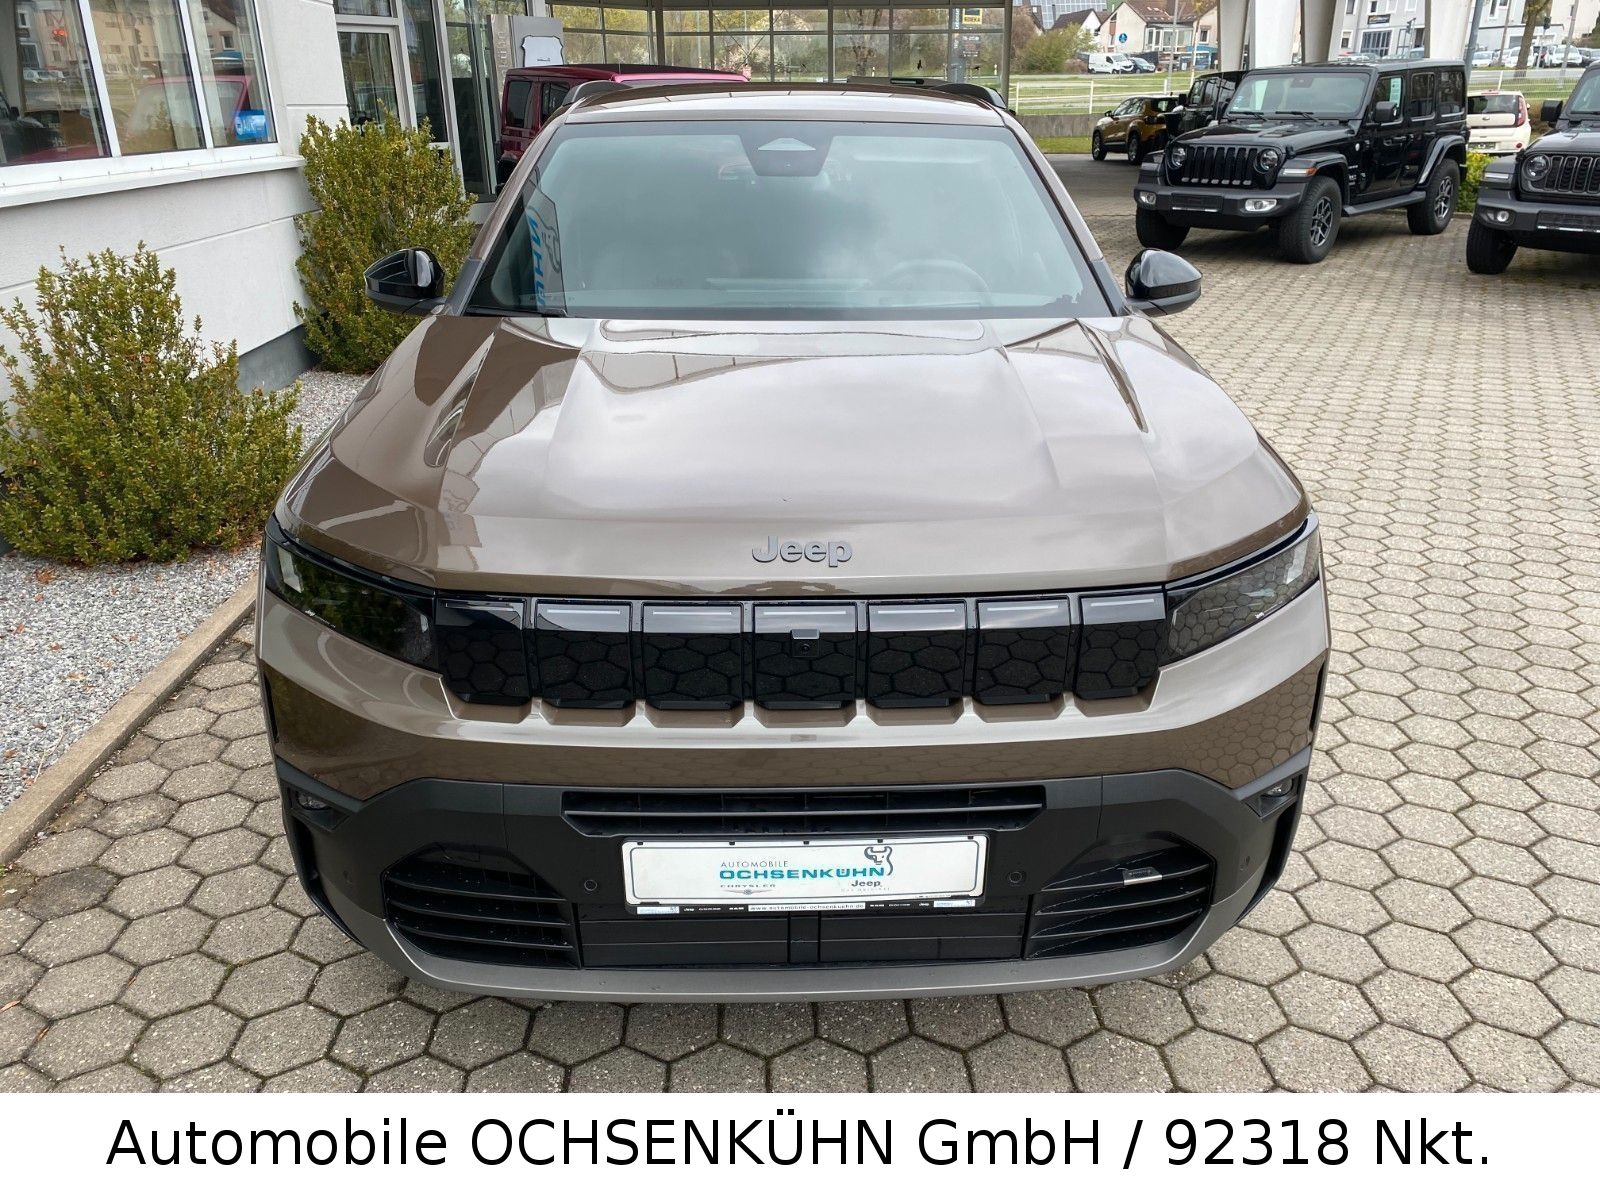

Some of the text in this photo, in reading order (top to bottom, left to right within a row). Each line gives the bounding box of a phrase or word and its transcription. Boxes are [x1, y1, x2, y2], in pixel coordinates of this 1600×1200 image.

[752, 535, 853, 568] Jeep
[720, 860, 790, 868] AUTOMOBILE
[719, 867, 885, 880] OCHSENKÜHN
[851, 879, 882, 888] Jeep
